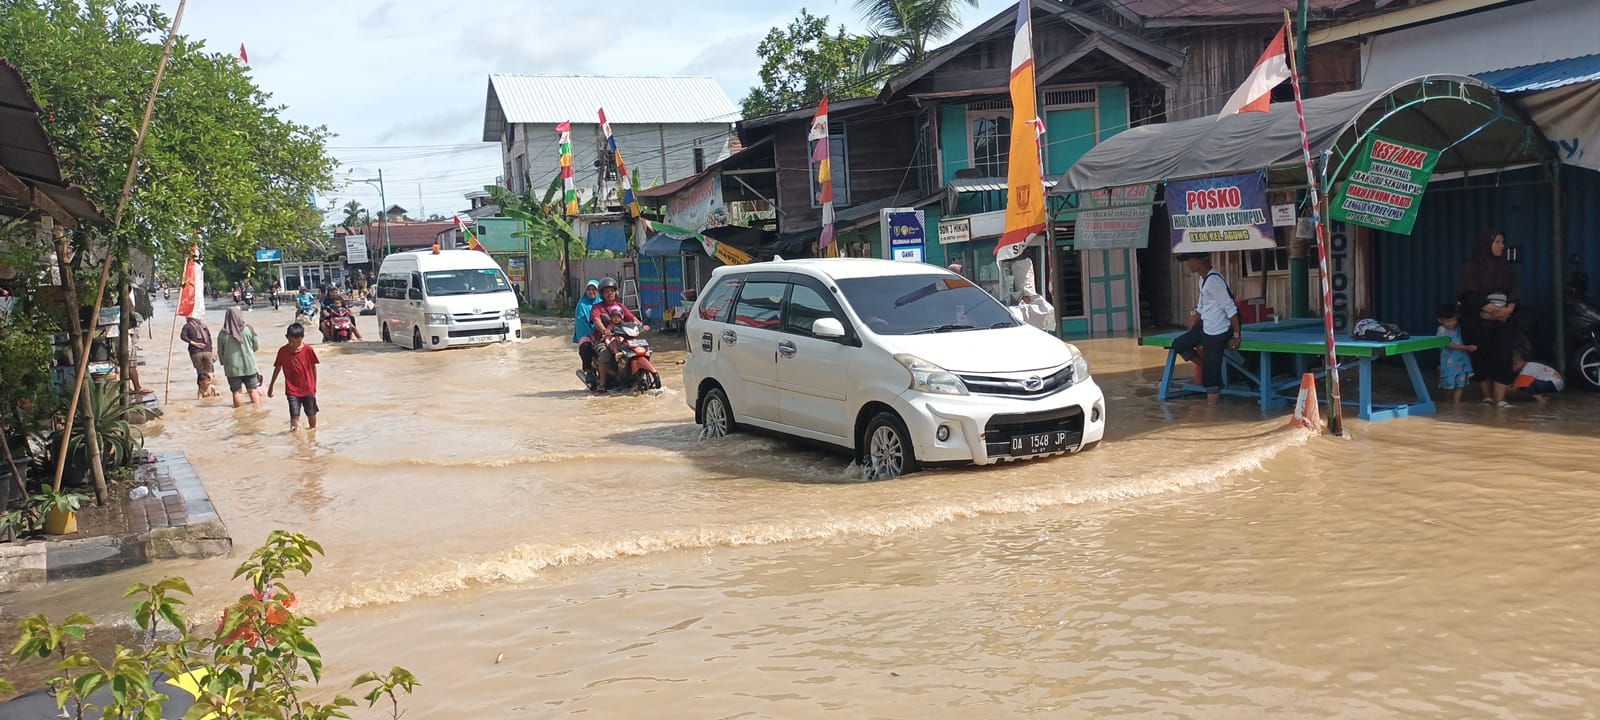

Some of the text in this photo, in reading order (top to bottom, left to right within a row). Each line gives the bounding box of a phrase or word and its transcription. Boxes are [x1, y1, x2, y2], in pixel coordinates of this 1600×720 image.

[1371, 140, 1427, 168] REST AREA
[1394, 166, 1411, 180] HAUL
[1187, 187, 1241, 211] POSKO
[1188, 213, 1206, 228] ABAH
[1207, 212, 1225, 227] GURU
[1227, 209, 1265, 226] SEKUMPUL
[939, 225, 949, 234] SDN
[1210, 230, 1223, 242] KEL.
[1224, 229, 1250, 241] AGUNG
[1012, 432, 1065, 450] DA 1548 JP
